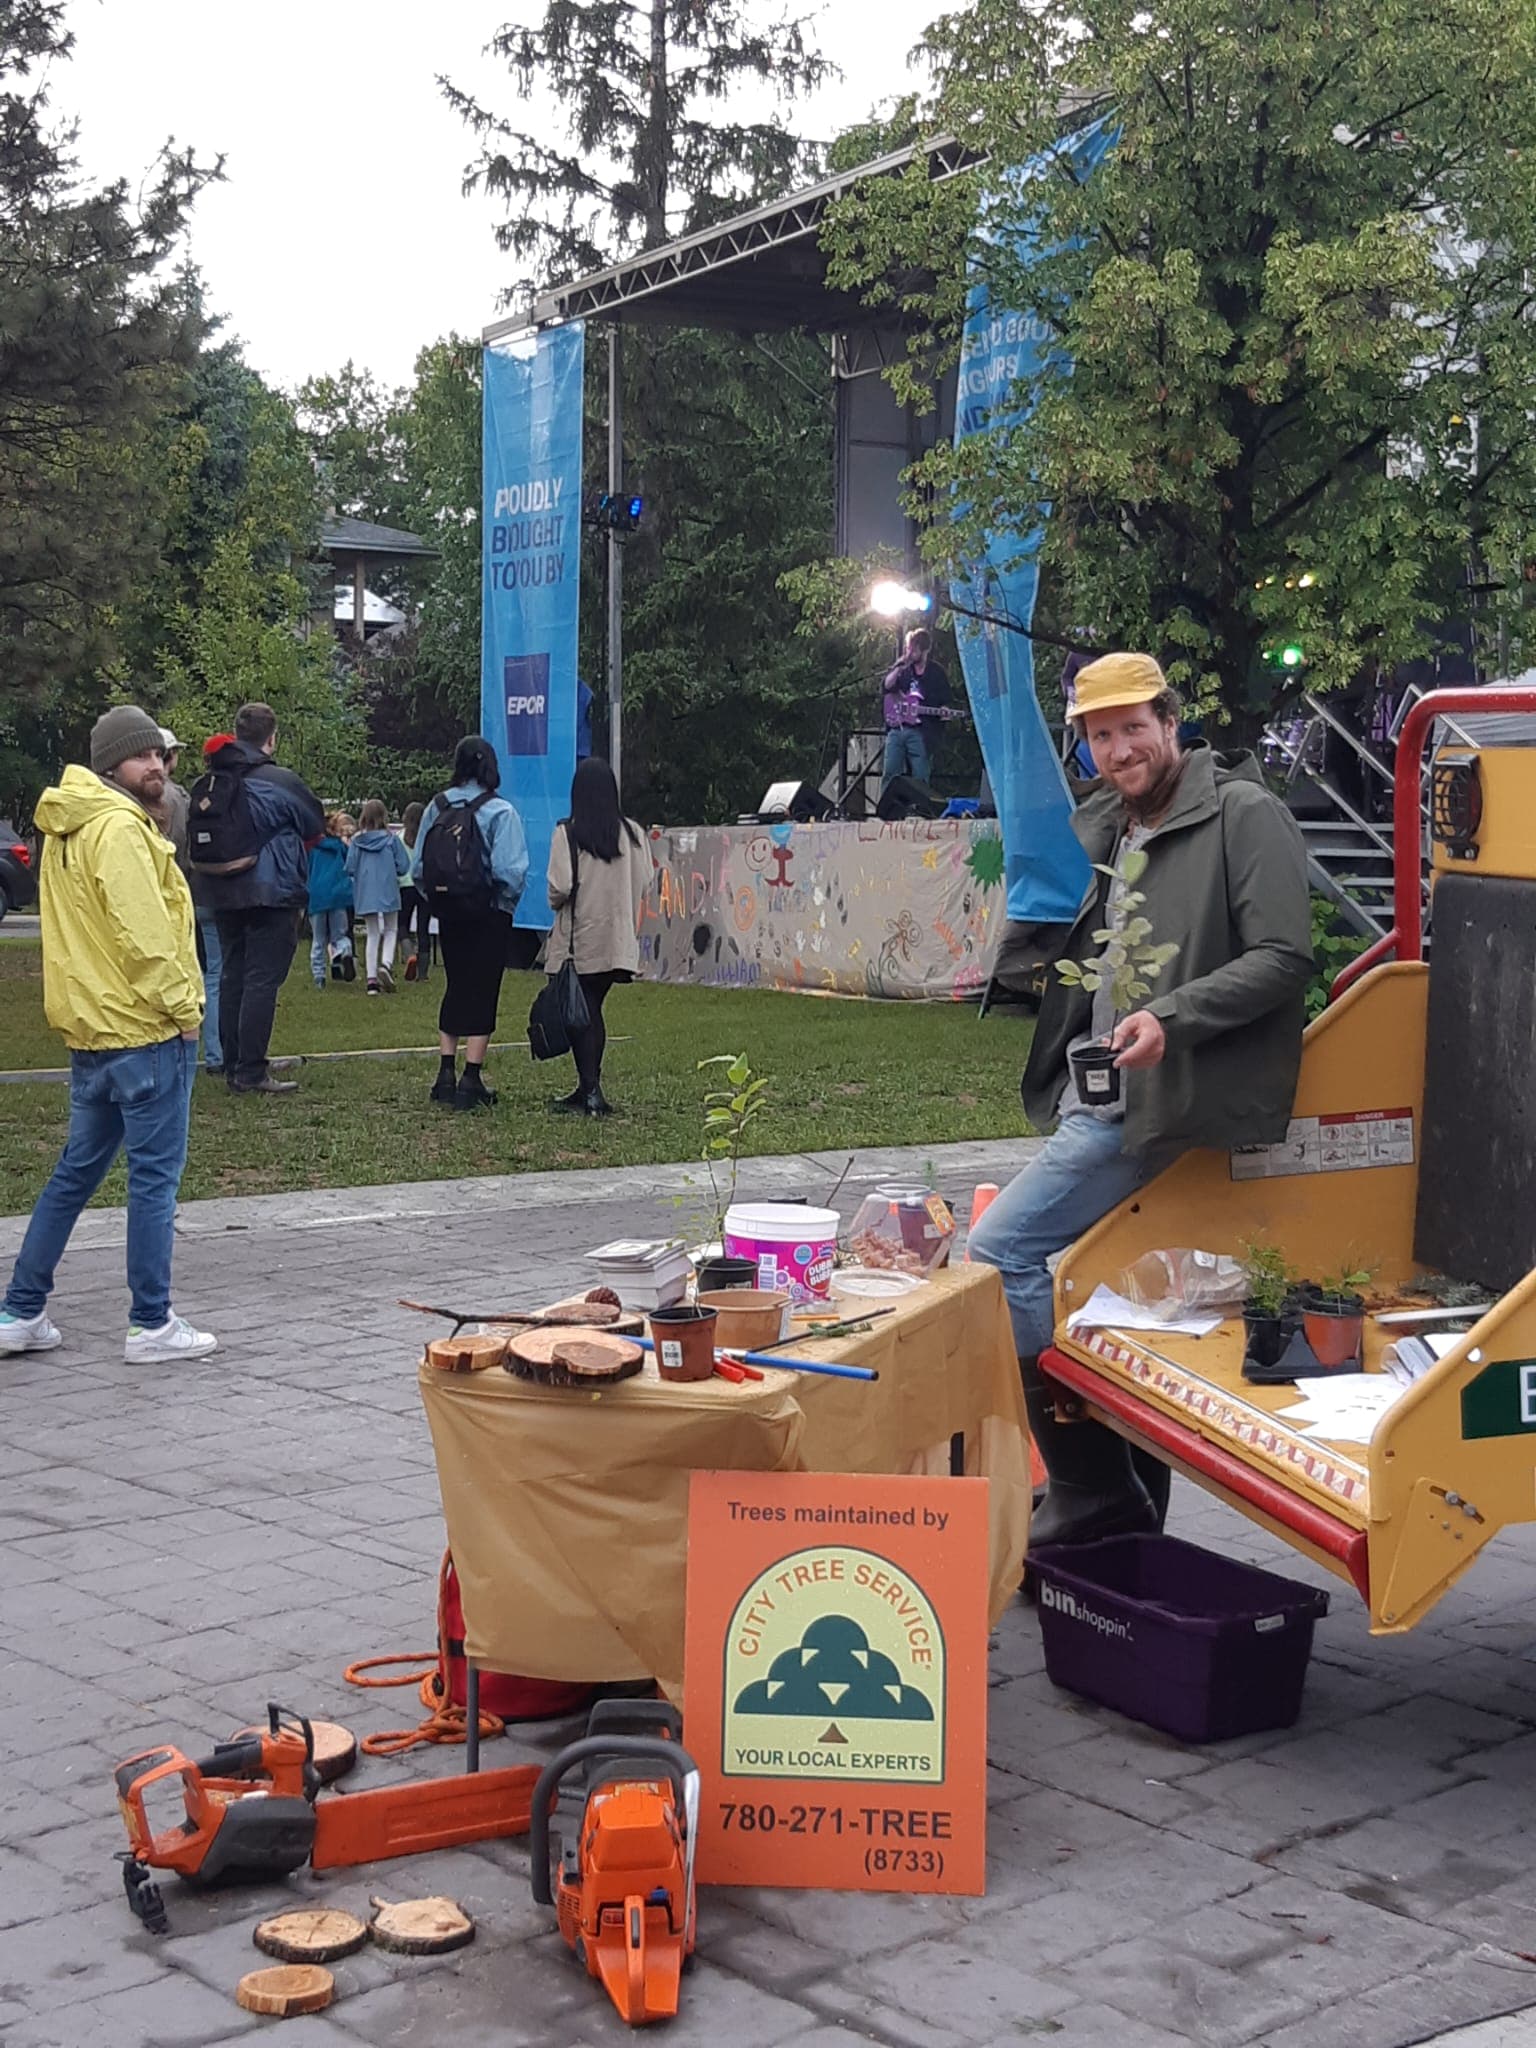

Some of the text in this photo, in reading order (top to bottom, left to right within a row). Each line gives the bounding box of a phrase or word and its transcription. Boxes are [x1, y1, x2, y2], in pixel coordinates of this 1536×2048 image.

[492, 515, 564, 554] BOUGHT
[545, 552, 565, 585] BY
[728, 1502, 949, 1531] Trees maintained by
[738, 1559, 932, 1666] CITY TREE SERVICE
[735, 1749, 931, 1771] YOUR LOCAL EXPERTS
[719, 1803, 952, 1839] 780-271-TREE
[864, 1848, 945, 1878] (8733)
